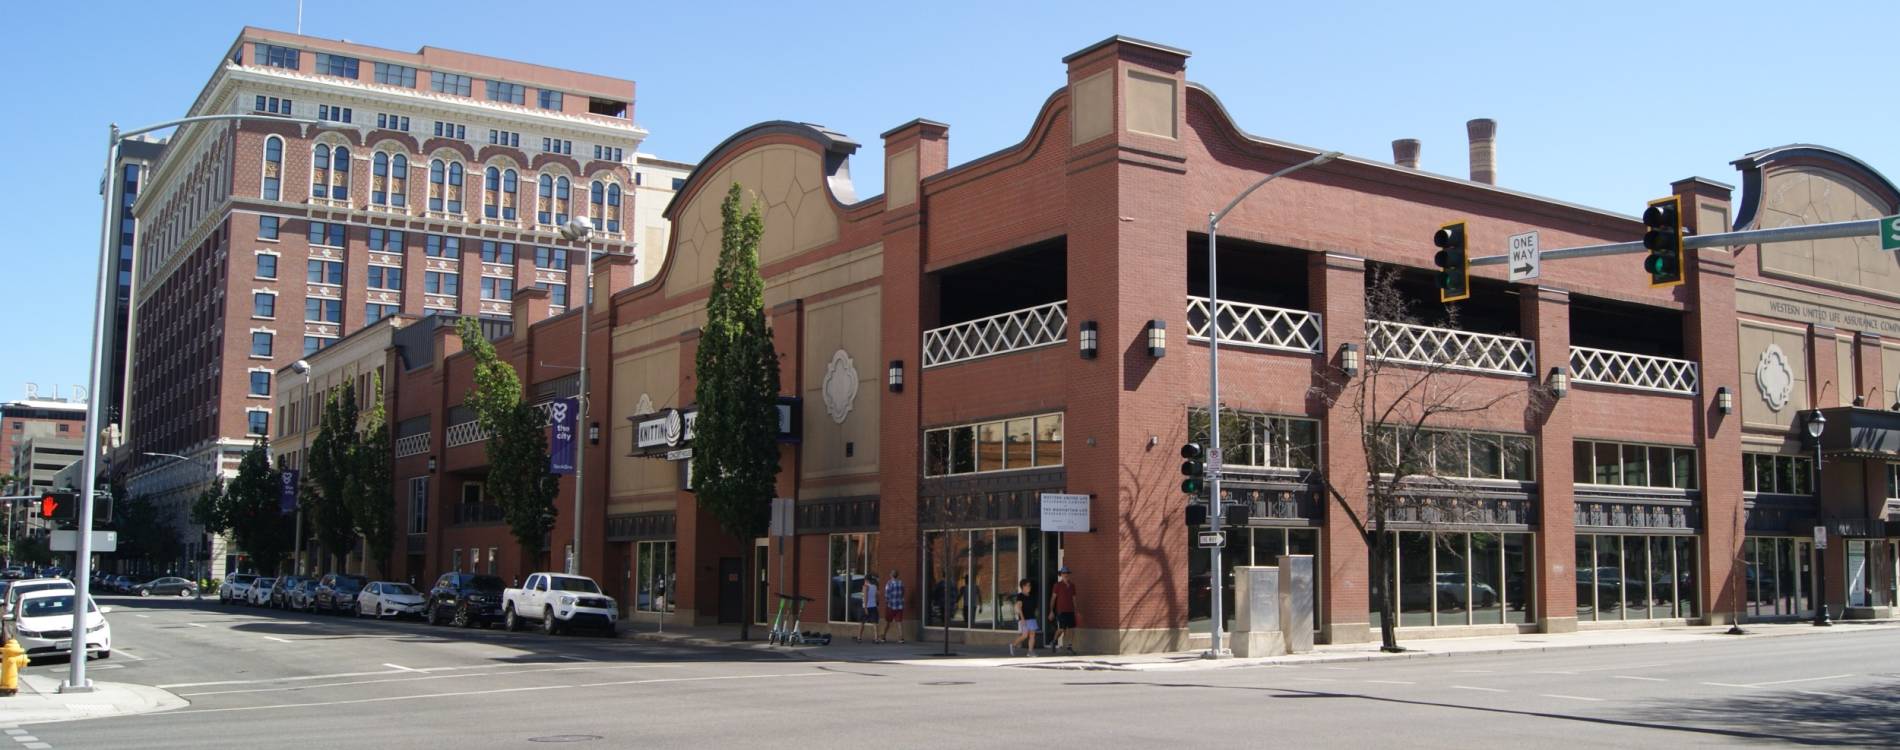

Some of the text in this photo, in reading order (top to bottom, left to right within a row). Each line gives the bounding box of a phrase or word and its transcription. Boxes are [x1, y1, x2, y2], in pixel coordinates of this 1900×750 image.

[1513, 235, 1533, 249] ONE
[1513, 248, 1534, 261] WAY
[1770, 301, 1800, 315] WESTERN
[1803, 308, 1827, 320] UNITED
[1829, 312, 1840, 322] LIFE
[1844, 316, 1879, 329] ASSURANCE
[556, 424, 570, 432] the
[556, 432, 571, 440] city
